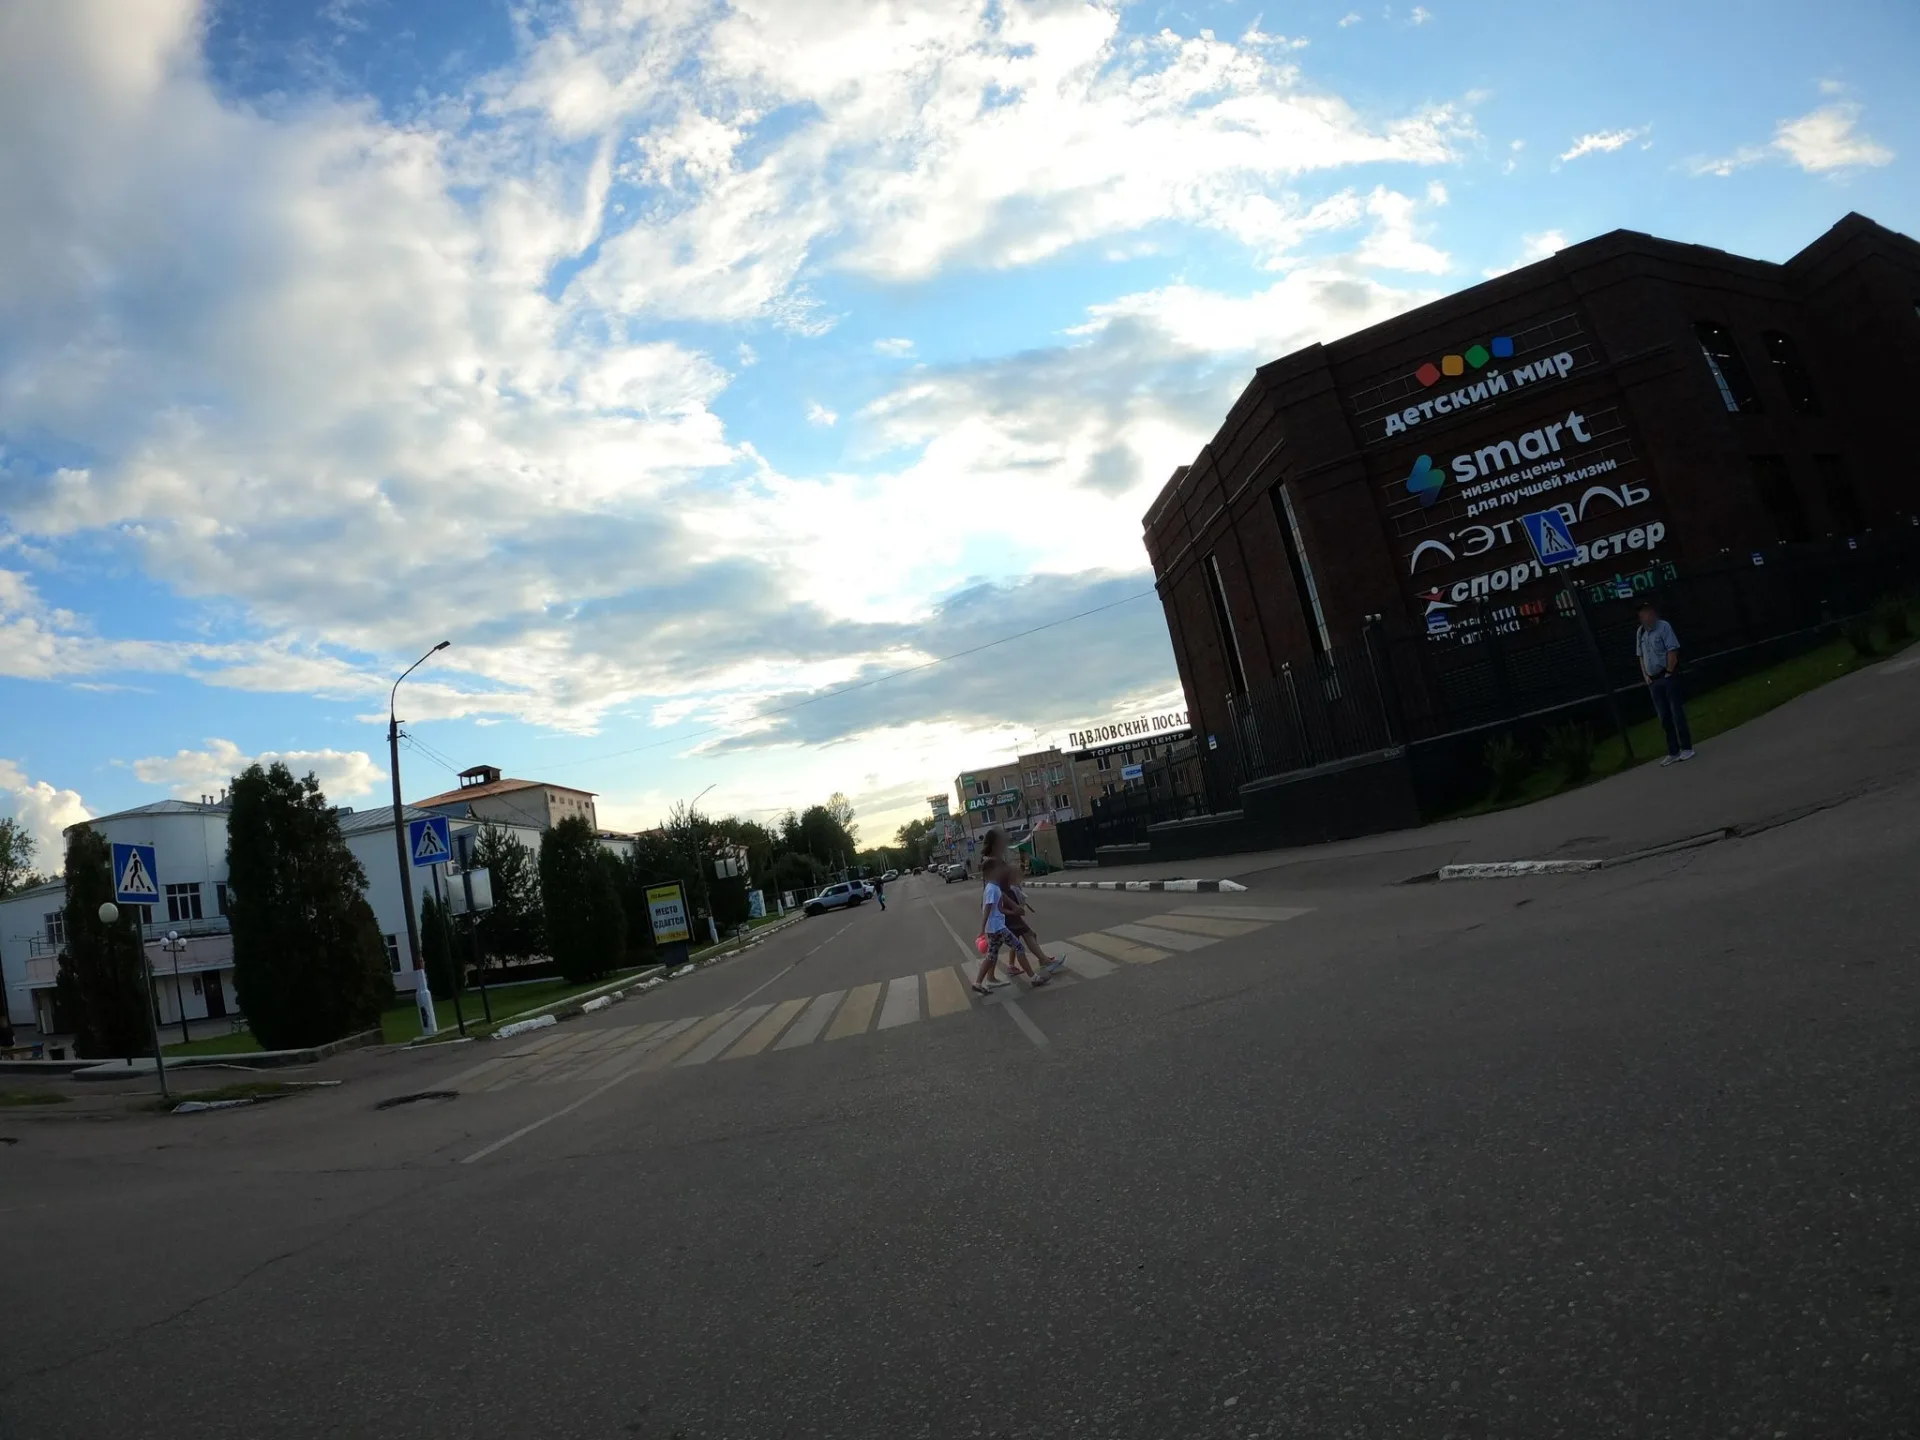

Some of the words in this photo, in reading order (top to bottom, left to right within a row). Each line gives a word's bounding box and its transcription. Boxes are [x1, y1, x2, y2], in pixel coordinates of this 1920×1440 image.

[1512, 352, 1574, 386] мир
[1451, 410, 1592, 483] smart
[1461, 472, 1520, 499] низкие
[1522, 457, 1566, 481] цены
[1467, 497, 1499, 518] для
[1500, 474, 1562, 505] лучшей
[1564, 458, 1617, 484] жизни
[1411, 484, 1651, 575] Л'ЭТАЛЬ
[1451, 521, 1666, 602] спортастер
[1069, 715, 1150, 747] ПАВЛОВСКИЙ
[1091, 739, 1149, 758] ТОРГОВЫЙ
[1151, 733, 1185, 746] ЦЕНТР
[653, 916, 685, 929] СДАЕТСЯ
[655, 905, 678, 917] МЕСТО
